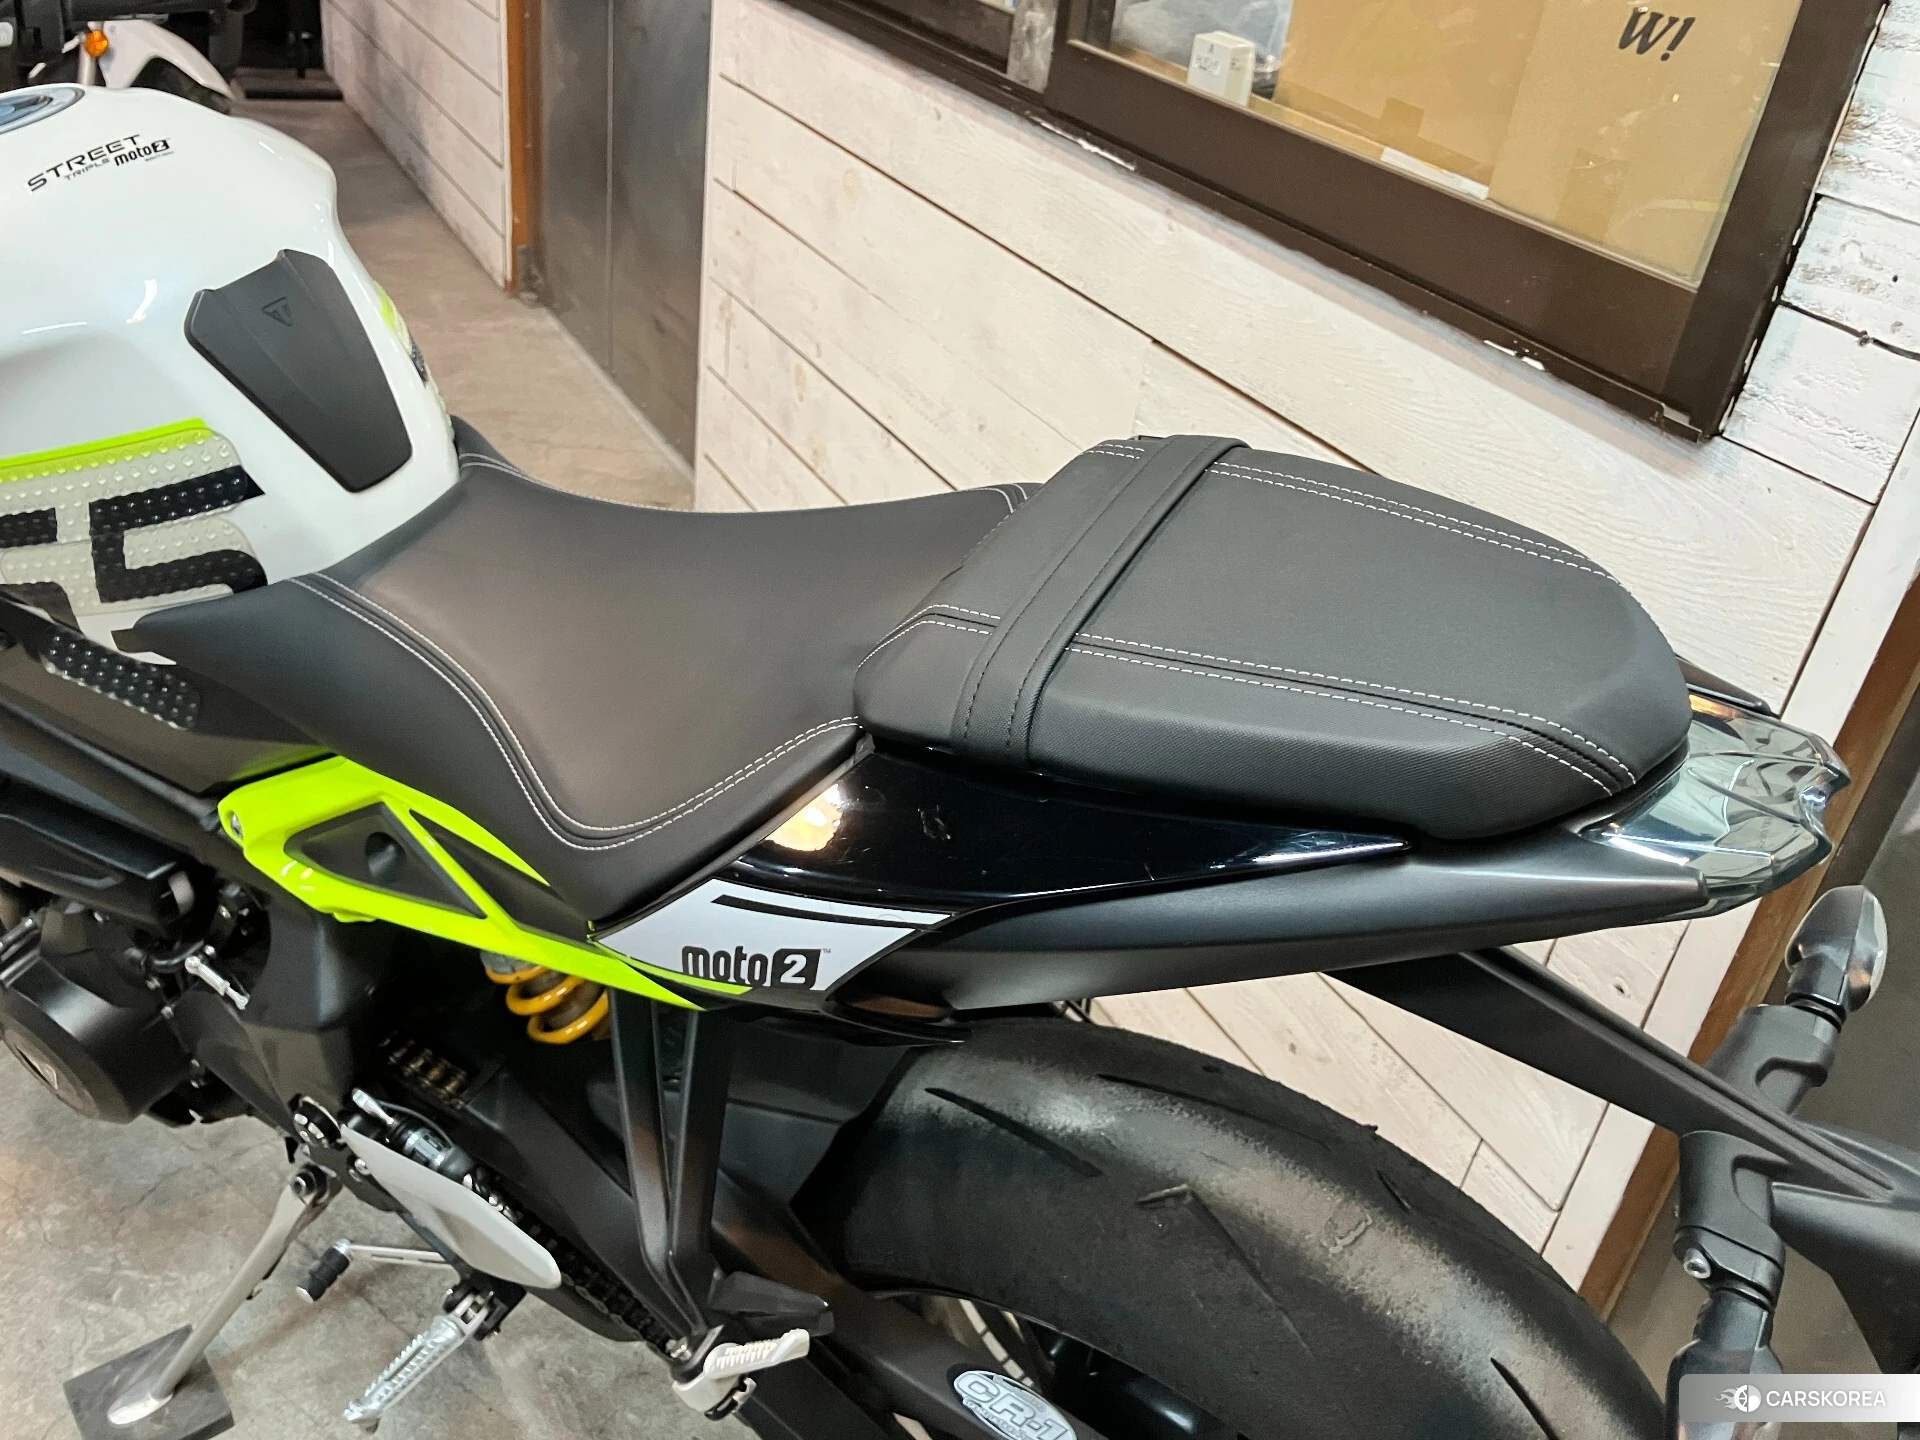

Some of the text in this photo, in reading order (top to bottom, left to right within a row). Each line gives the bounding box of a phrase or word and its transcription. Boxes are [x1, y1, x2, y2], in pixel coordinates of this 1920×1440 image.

[1618, 7, 1696, 61] W!
[27, 134, 141, 192] STREET
[114, 139, 170, 166] moto2
[682, 945, 821, 990] moto2
